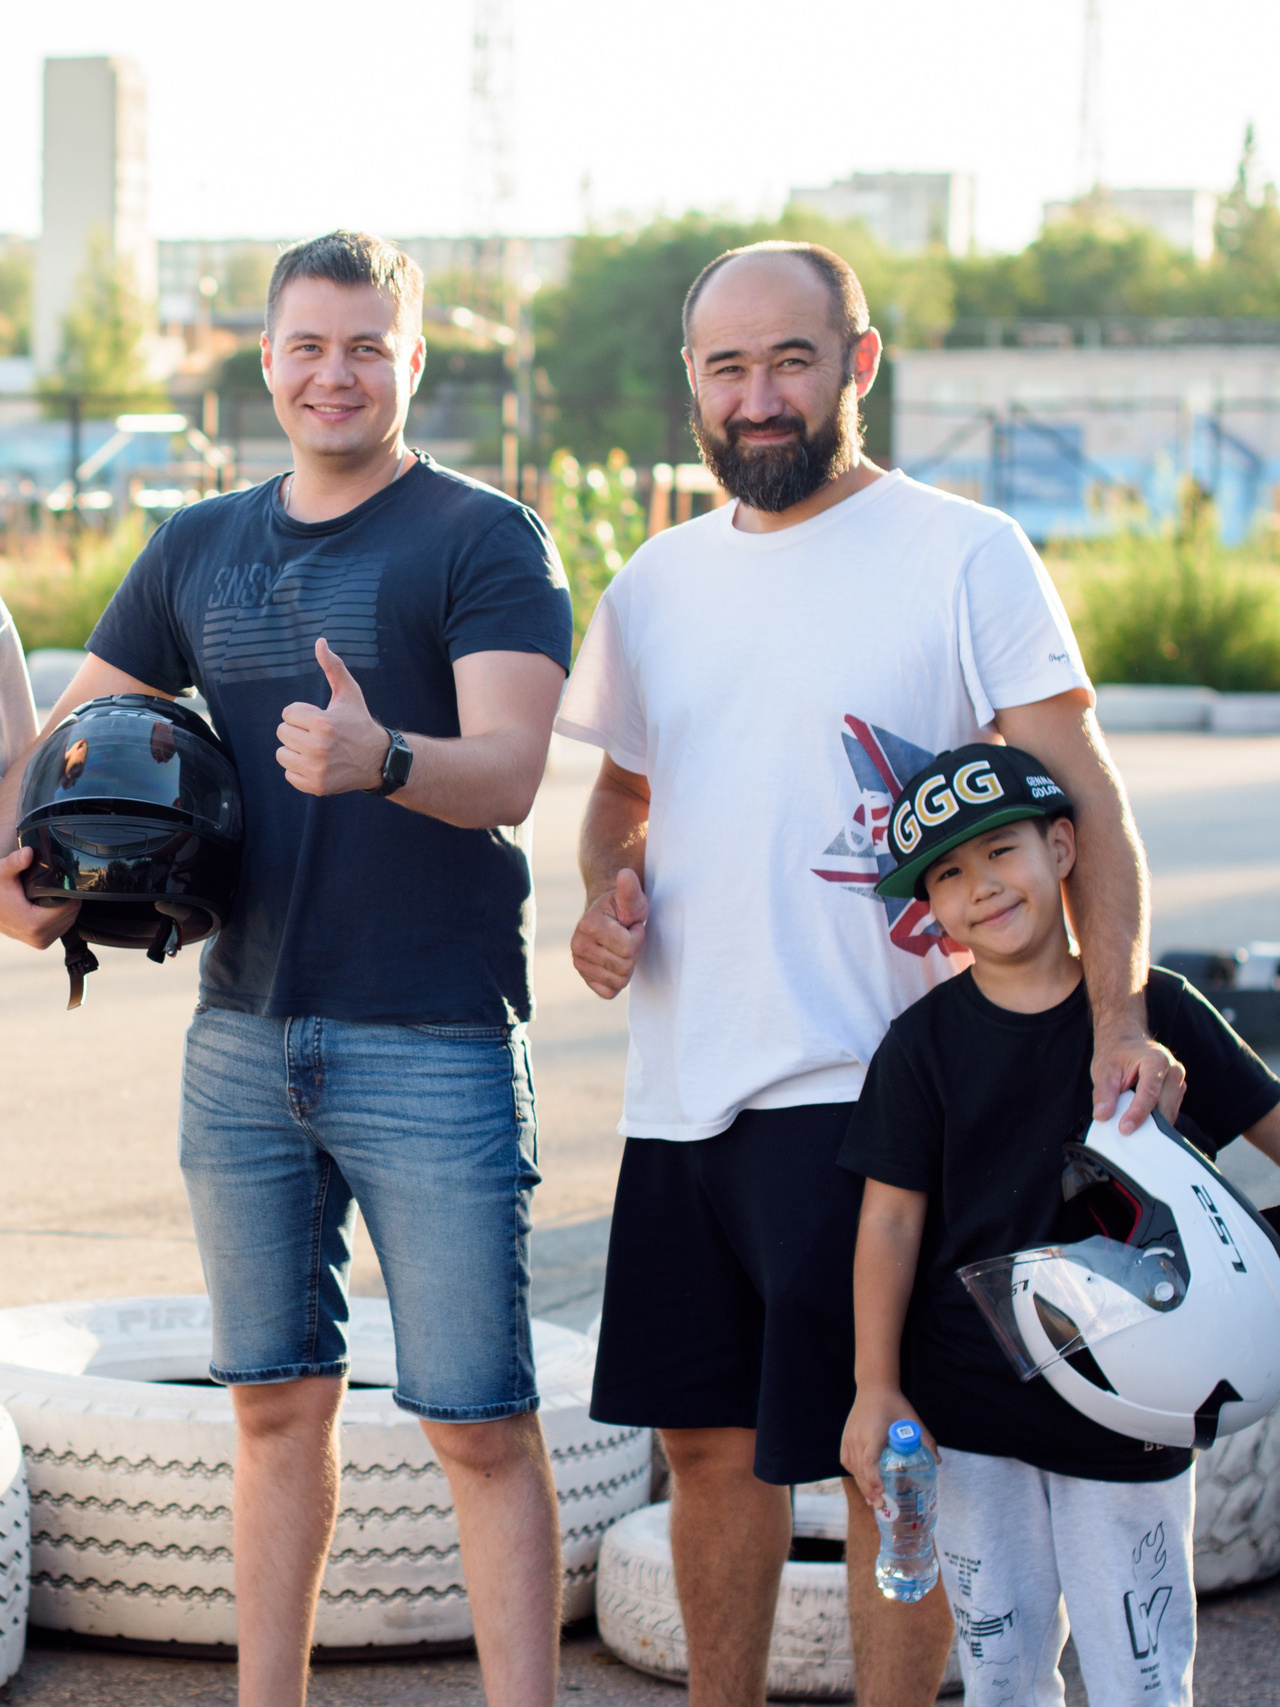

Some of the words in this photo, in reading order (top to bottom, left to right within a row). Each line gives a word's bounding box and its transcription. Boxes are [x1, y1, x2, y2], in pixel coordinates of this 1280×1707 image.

[893, 759, 1005, 854] GGG
[1191, 1184, 1248, 1274] LS2
[117, 1306, 212, 1333] PIR
